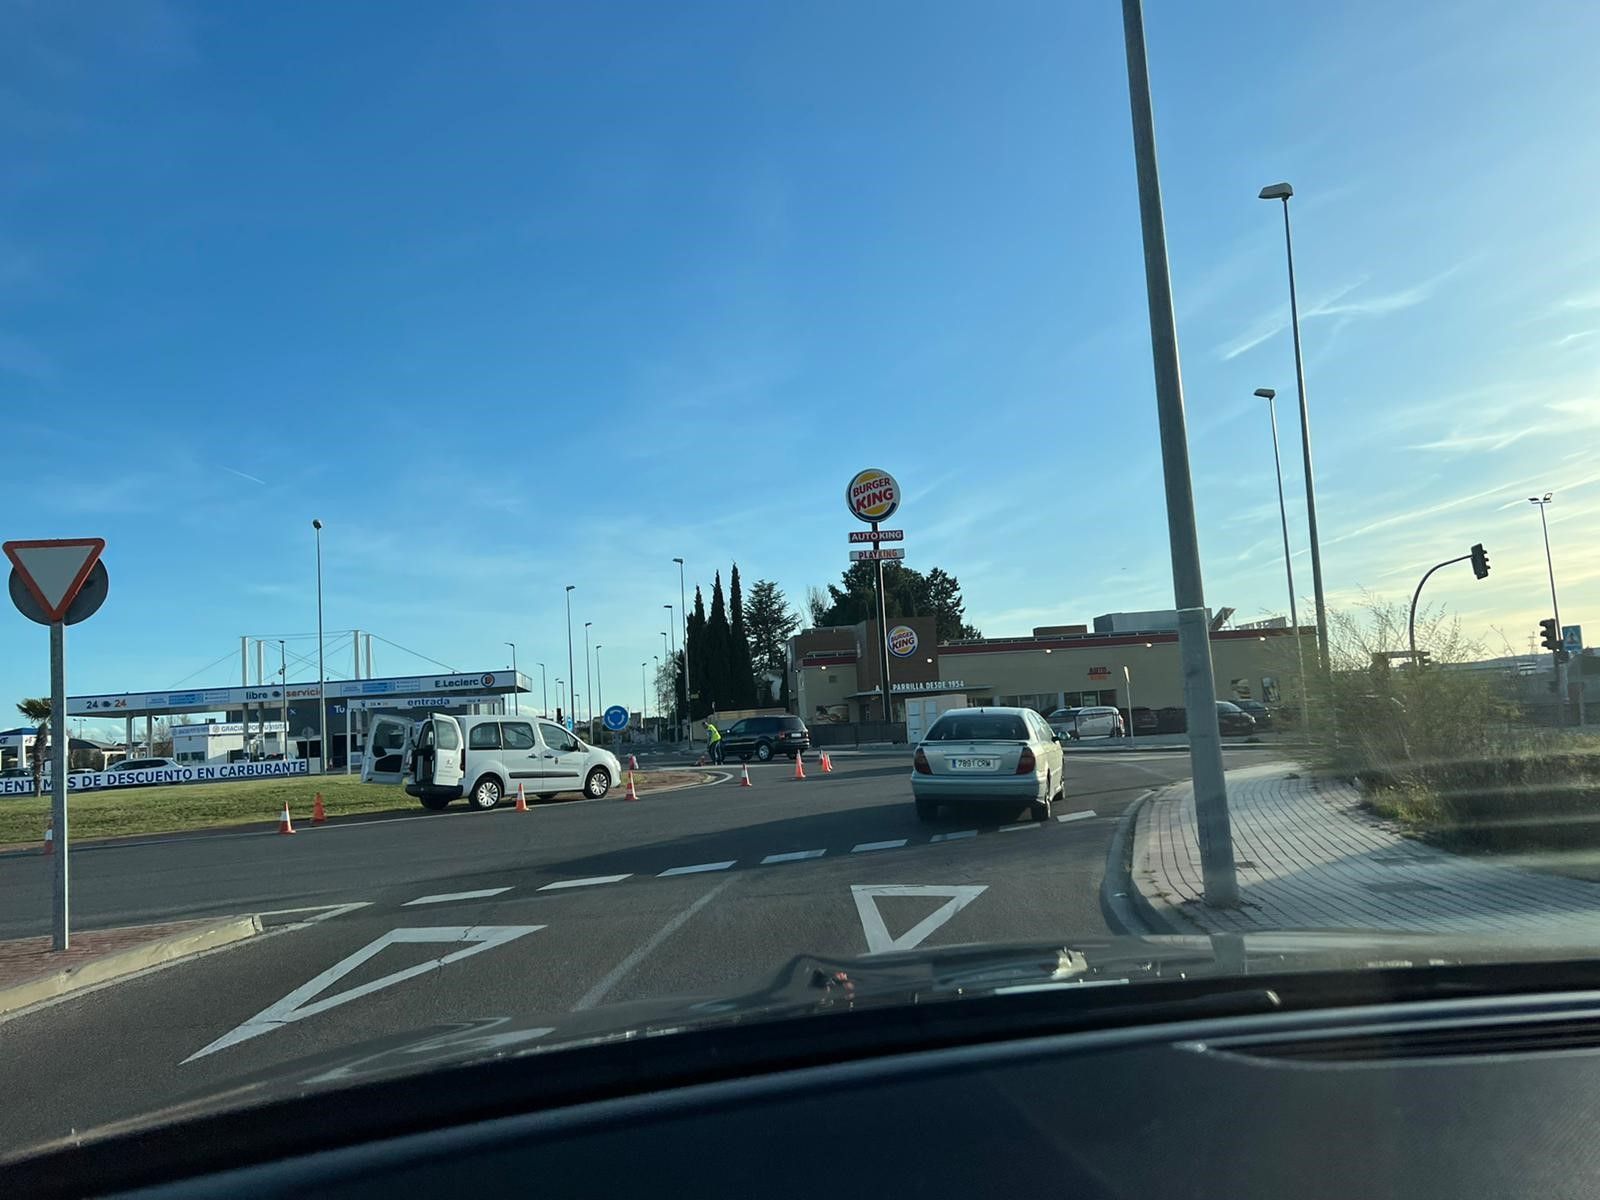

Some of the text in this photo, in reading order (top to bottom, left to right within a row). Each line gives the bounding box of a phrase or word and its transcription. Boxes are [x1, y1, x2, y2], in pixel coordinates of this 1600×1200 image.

[853, 477, 891, 497] BURGER
[855, 488, 893, 512] KING
[891, 632, 913, 641] BURGER
[892, 638, 915, 650] KING
[435, 678, 479, 688] E.Leclerc
[246, 688, 321, 699] libre servici
[86, 699, 127, 709] 24 24
[407, 698, 450, 706] entrada
[82, 774, 102, 787] DE
[107, 768, 193, 785] DESCUENTO
[197, 767, 215, 778] EN
[219, 760, 306, 777] CARBURANTE
